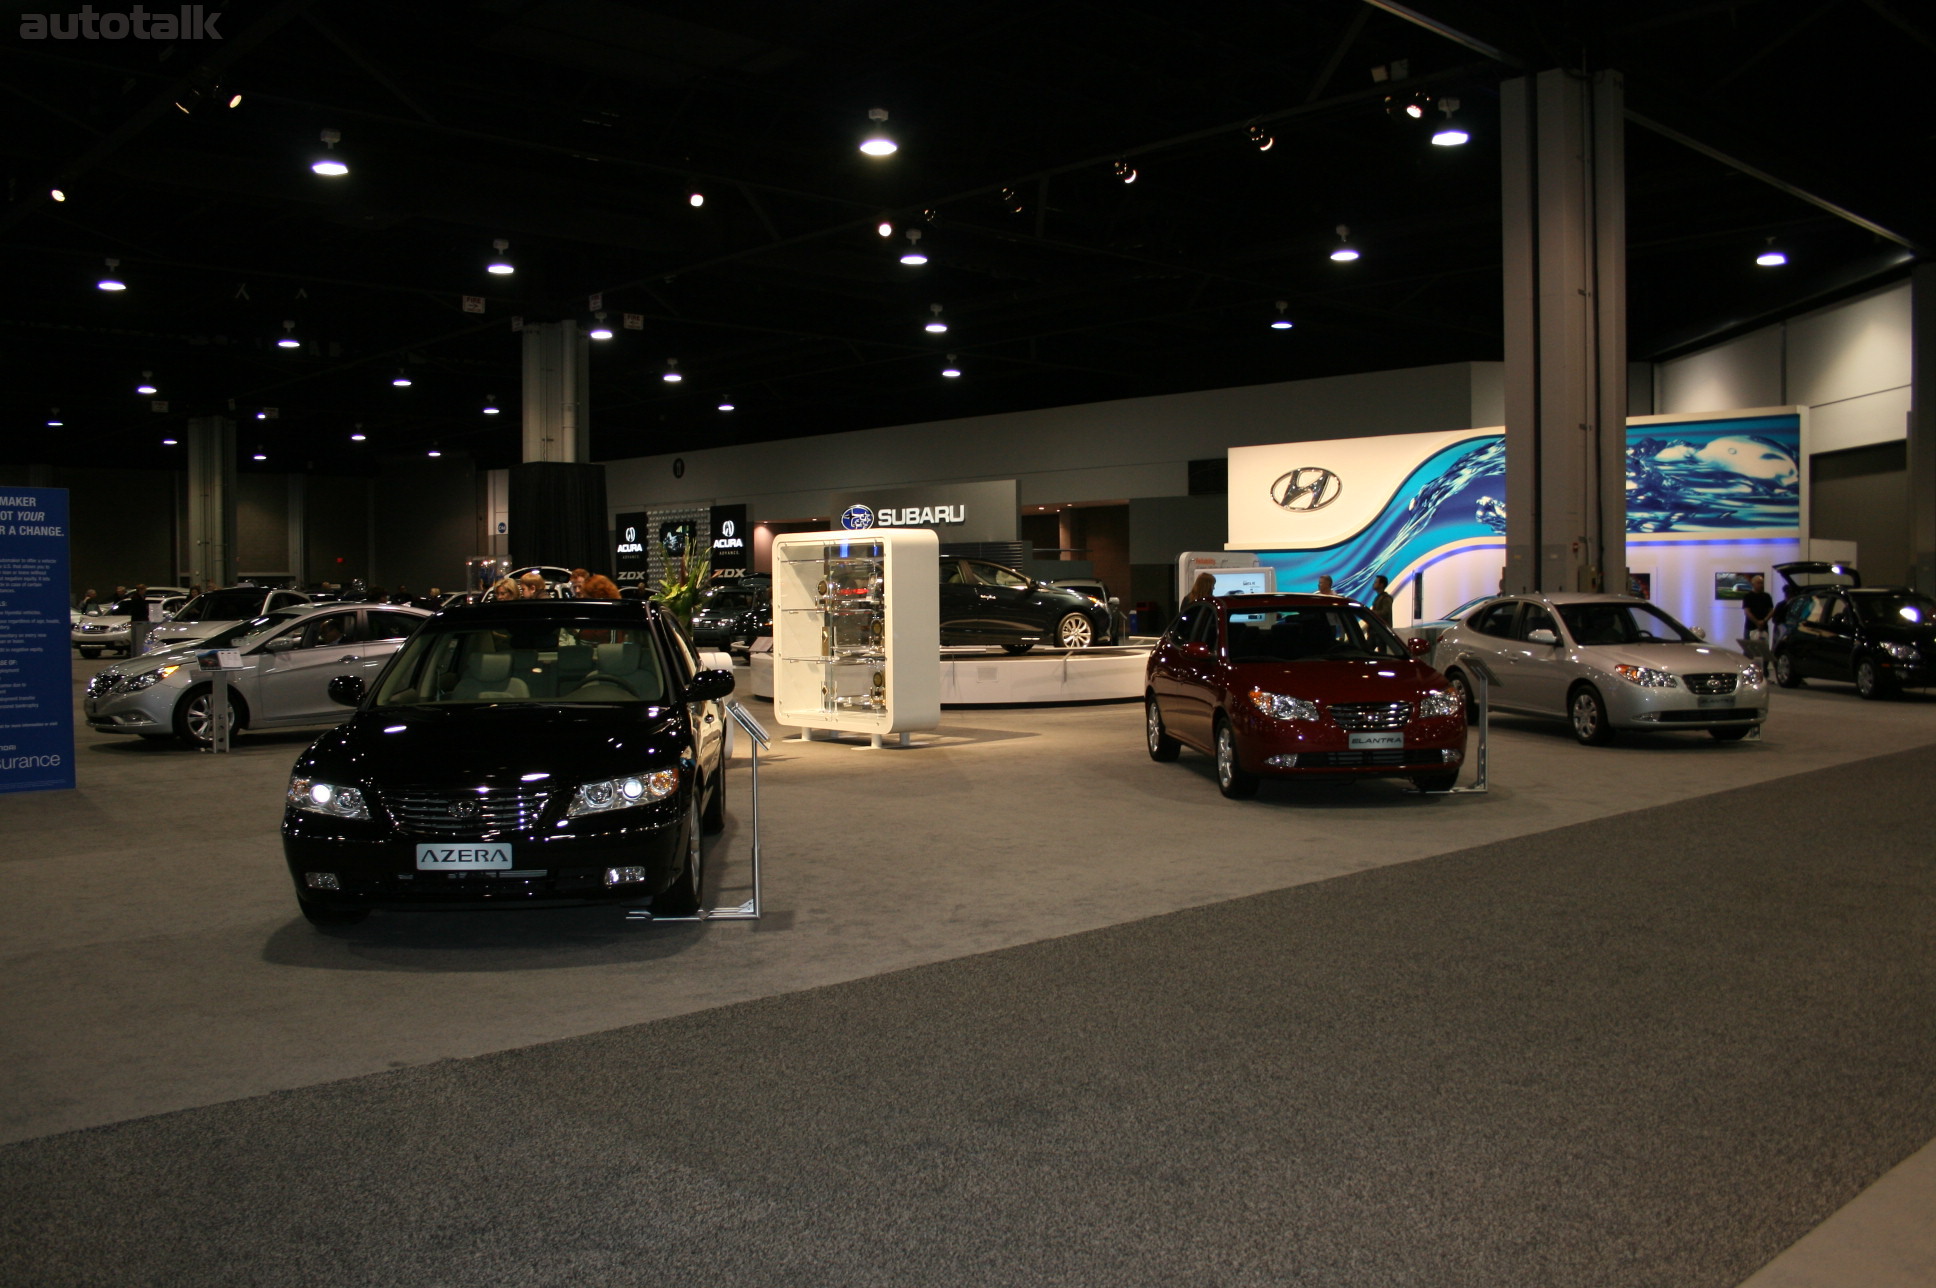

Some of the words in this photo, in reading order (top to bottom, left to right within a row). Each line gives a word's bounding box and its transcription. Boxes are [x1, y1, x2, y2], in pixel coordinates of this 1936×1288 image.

[17, 511, 46, 522] YOUR
[878, 504, 965, 526] SUBARU
[8, 525, 17, 536] A
[19, 525, 65, 537] CHANGE.
[617, 543, 643, 553] ACURA
[712, 538, 744, 549] ACURA
[617, 571, 646, 581] ZDX
[1351, 737, 1403, 745] ELANTRA
[0, 754, 61, 770] urance
[421, 849, 509, 863] AZERA
